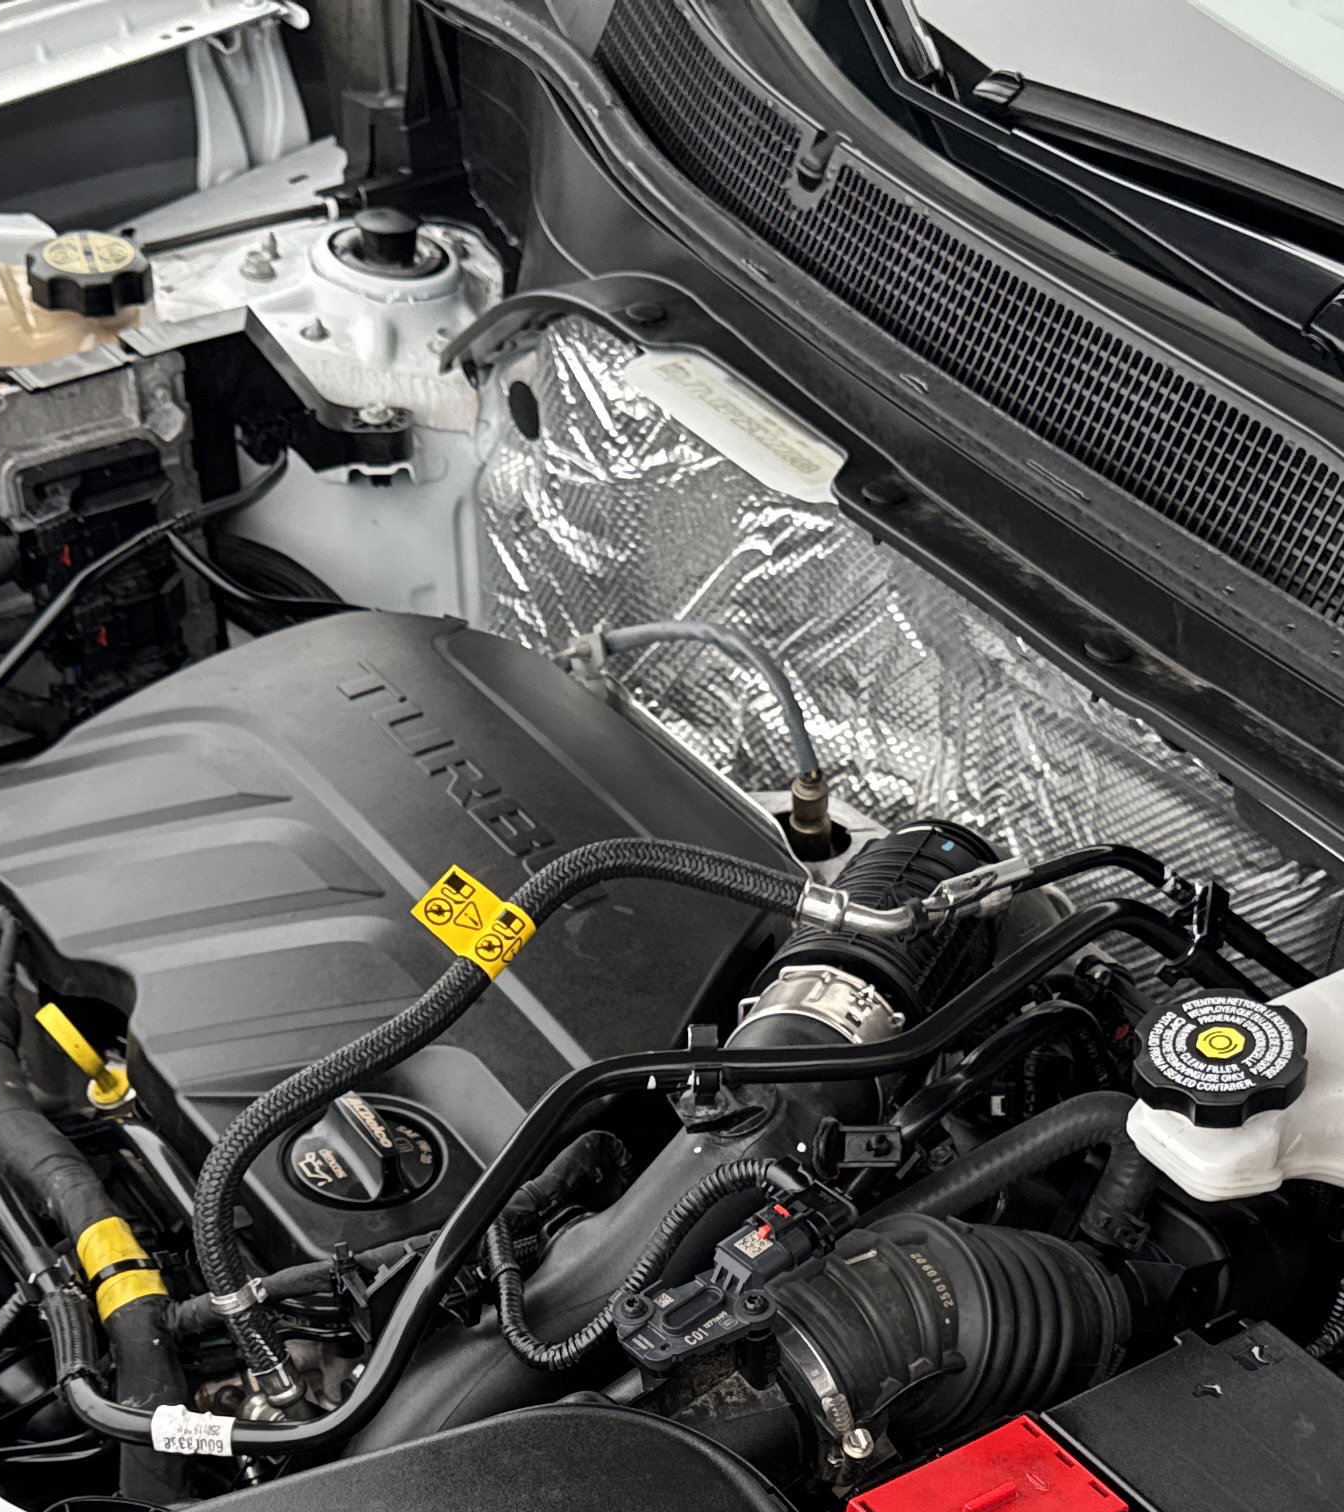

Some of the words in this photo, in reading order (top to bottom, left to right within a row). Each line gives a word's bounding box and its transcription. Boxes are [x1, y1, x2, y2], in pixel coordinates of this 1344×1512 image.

[336, 660, 556, 876] TURB
[1180, 1052, 1207, 1071] CLEAN
[1206, 1064, 1240, 1073] FILLER
[1163, 1067, 1196, 1088] SEALED
[1221, 1072, 1245, 1081] ONLY
